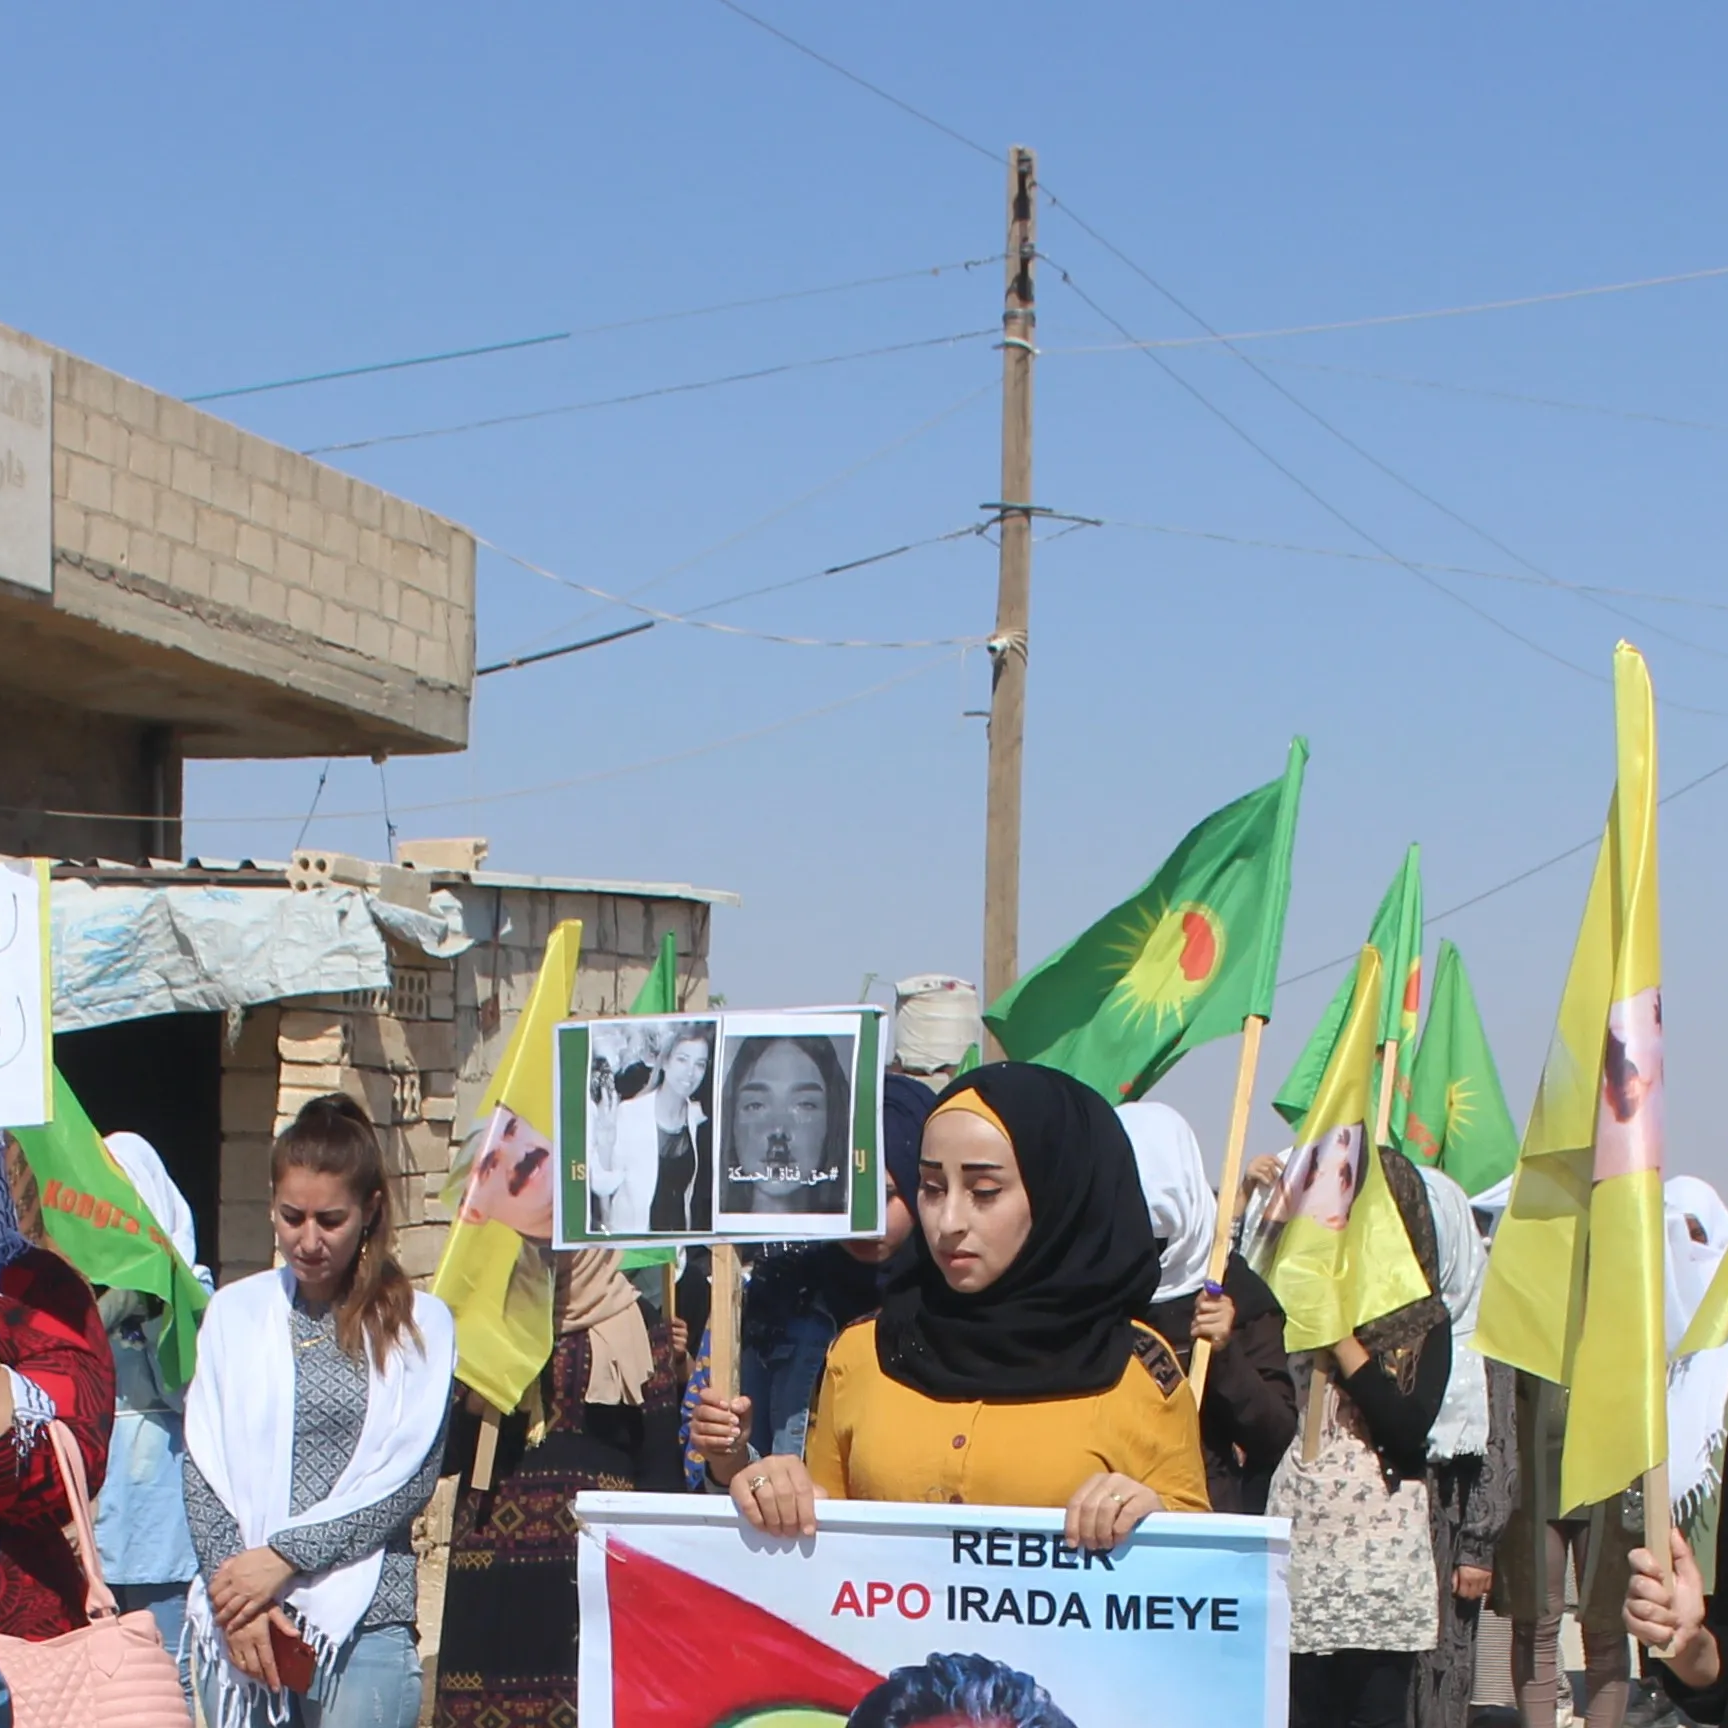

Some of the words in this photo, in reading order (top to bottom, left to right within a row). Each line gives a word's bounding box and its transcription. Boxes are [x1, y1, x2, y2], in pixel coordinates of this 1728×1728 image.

[831, 1580, 931, 1620] APO
[946, 1585, 1091, 1629] IRADA
[1104, 1593, 1240, 1632] MEYE
